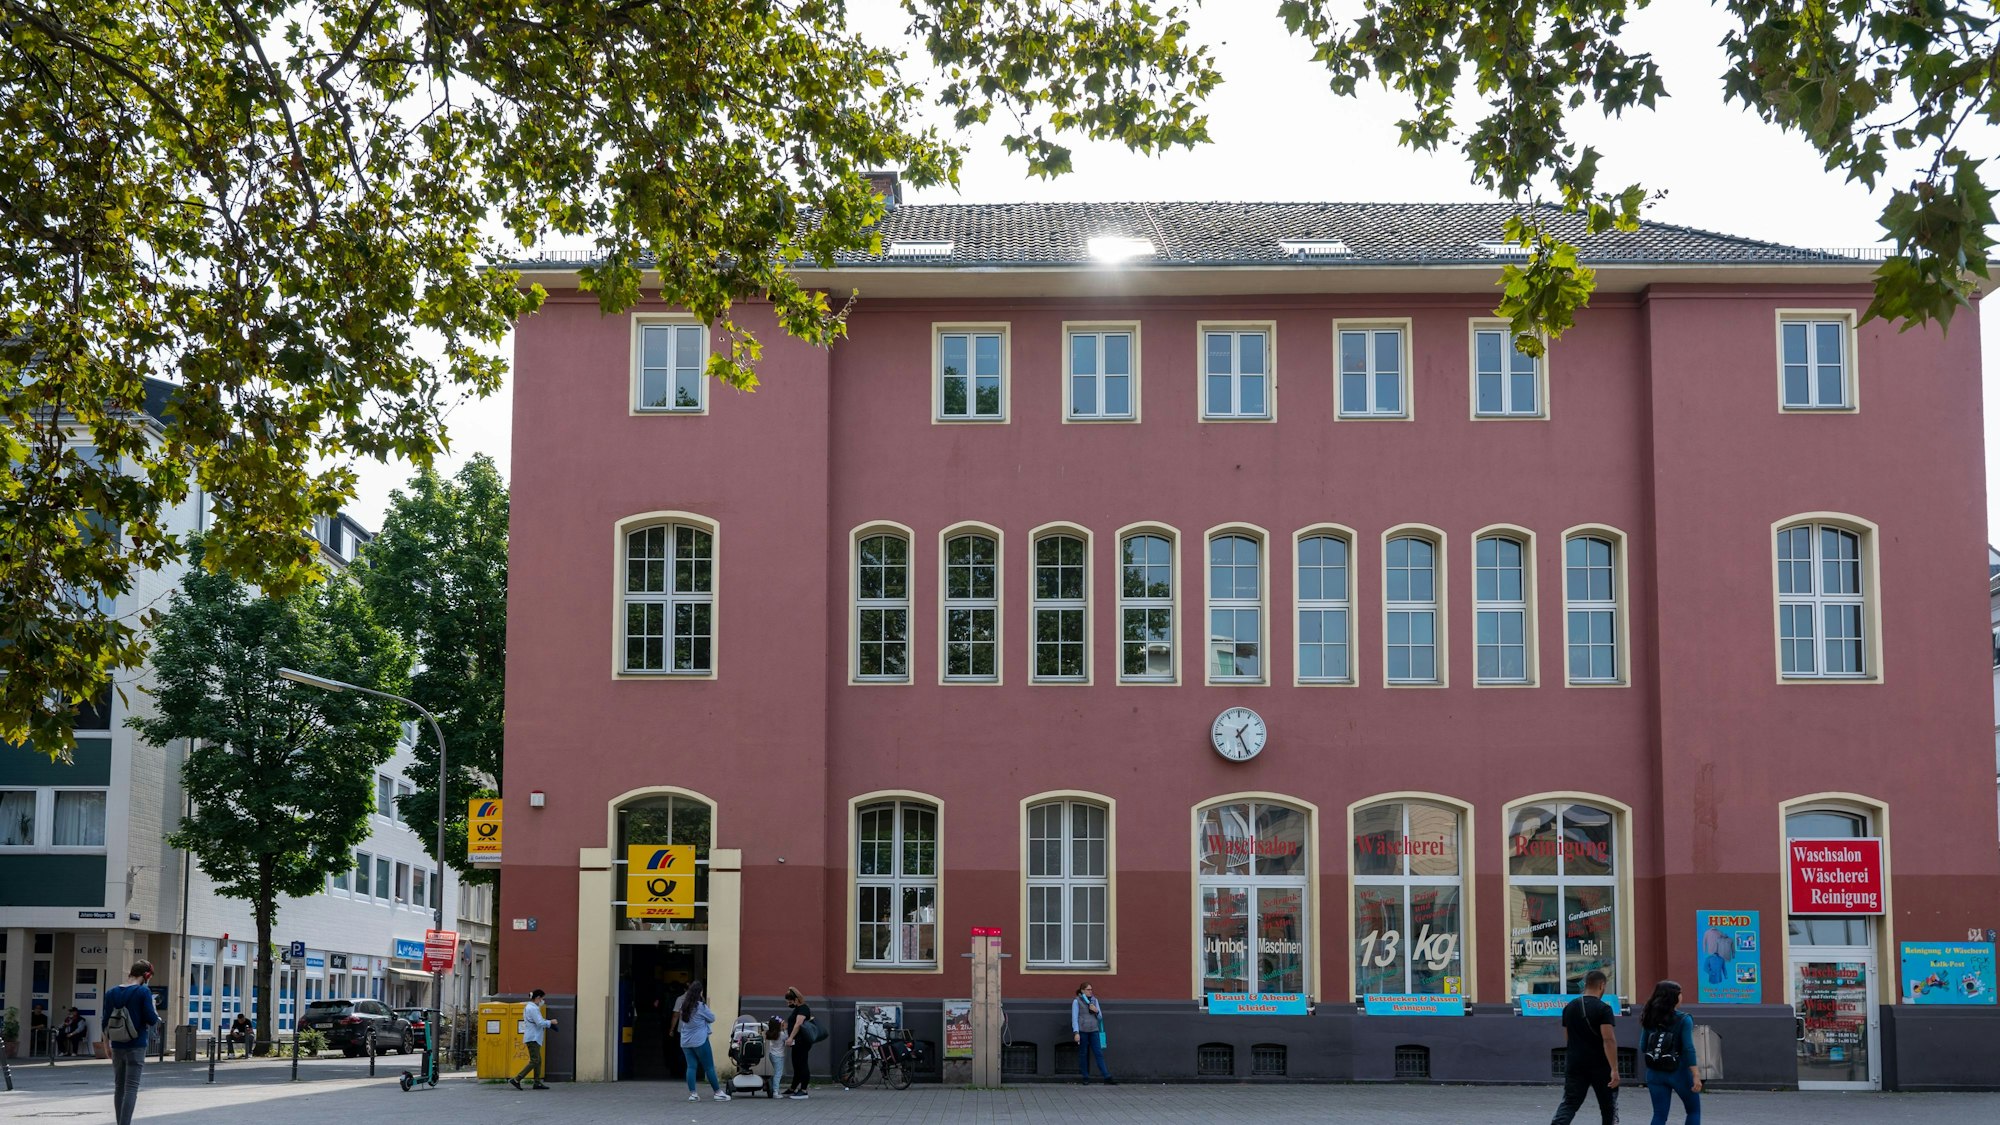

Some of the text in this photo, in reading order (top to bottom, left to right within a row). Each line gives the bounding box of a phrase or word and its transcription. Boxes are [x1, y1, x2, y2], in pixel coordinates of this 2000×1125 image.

[1208, 835, 1297, 855] Waschsalon
[1357, 835, 1444, 855] Wäscherei
[1514, 835, 1608, 862] Reinigung
[1793, 846, 1862, 862] Waschsalon
[1801, 867, 1869, 883] Wäscherei
[1811, 888, 1877, 908] Reinigung
[1568, 905, 1611, 921] Gardinenservice
[1708, 916, 1751, 927] HEMD
[1511, 919, 1557, 937] Hemdenservice
[292, 944, 301, 956] P
[1204, 937, 1302, 954] Jumbo- Maschinen
[1360, 923, 1458, 971] 13 kg
[1525, 936, 1557, 960] große
[1578, 939, 1598, 956] Teile
[1800, 967, 1858, 978] Waschsalon
